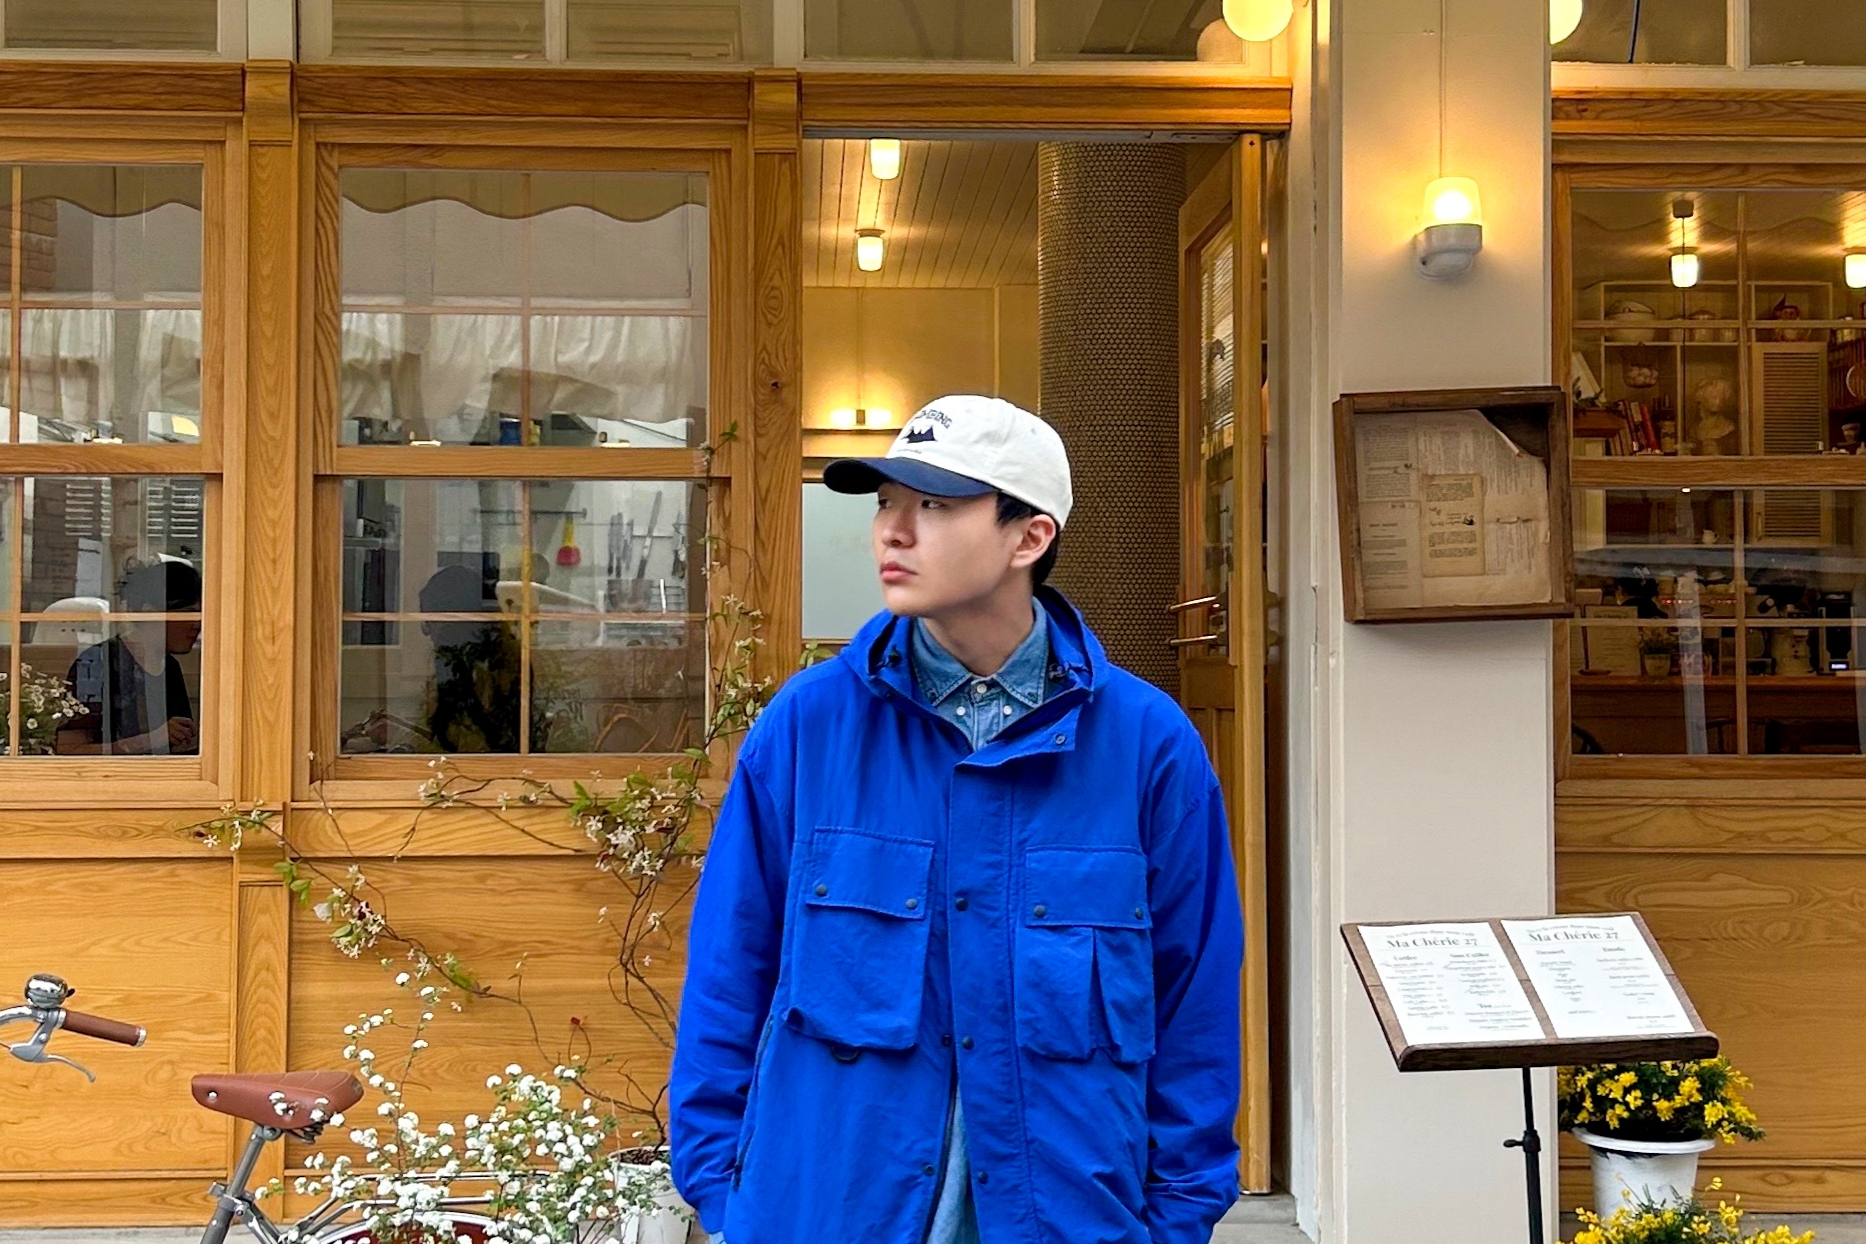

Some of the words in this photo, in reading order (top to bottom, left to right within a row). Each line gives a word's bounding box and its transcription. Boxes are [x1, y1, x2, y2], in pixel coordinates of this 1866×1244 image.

[1387, 939, 1410, 948] Ma
[1412, 936, 1460, 947] Chérie
[1464, 938, 1478, 947] 27
[1528, 932, 1552, 942] Ma
[1554, 930, 1602, 941] Chérie
[1605, 931, 1619, 941] 27
